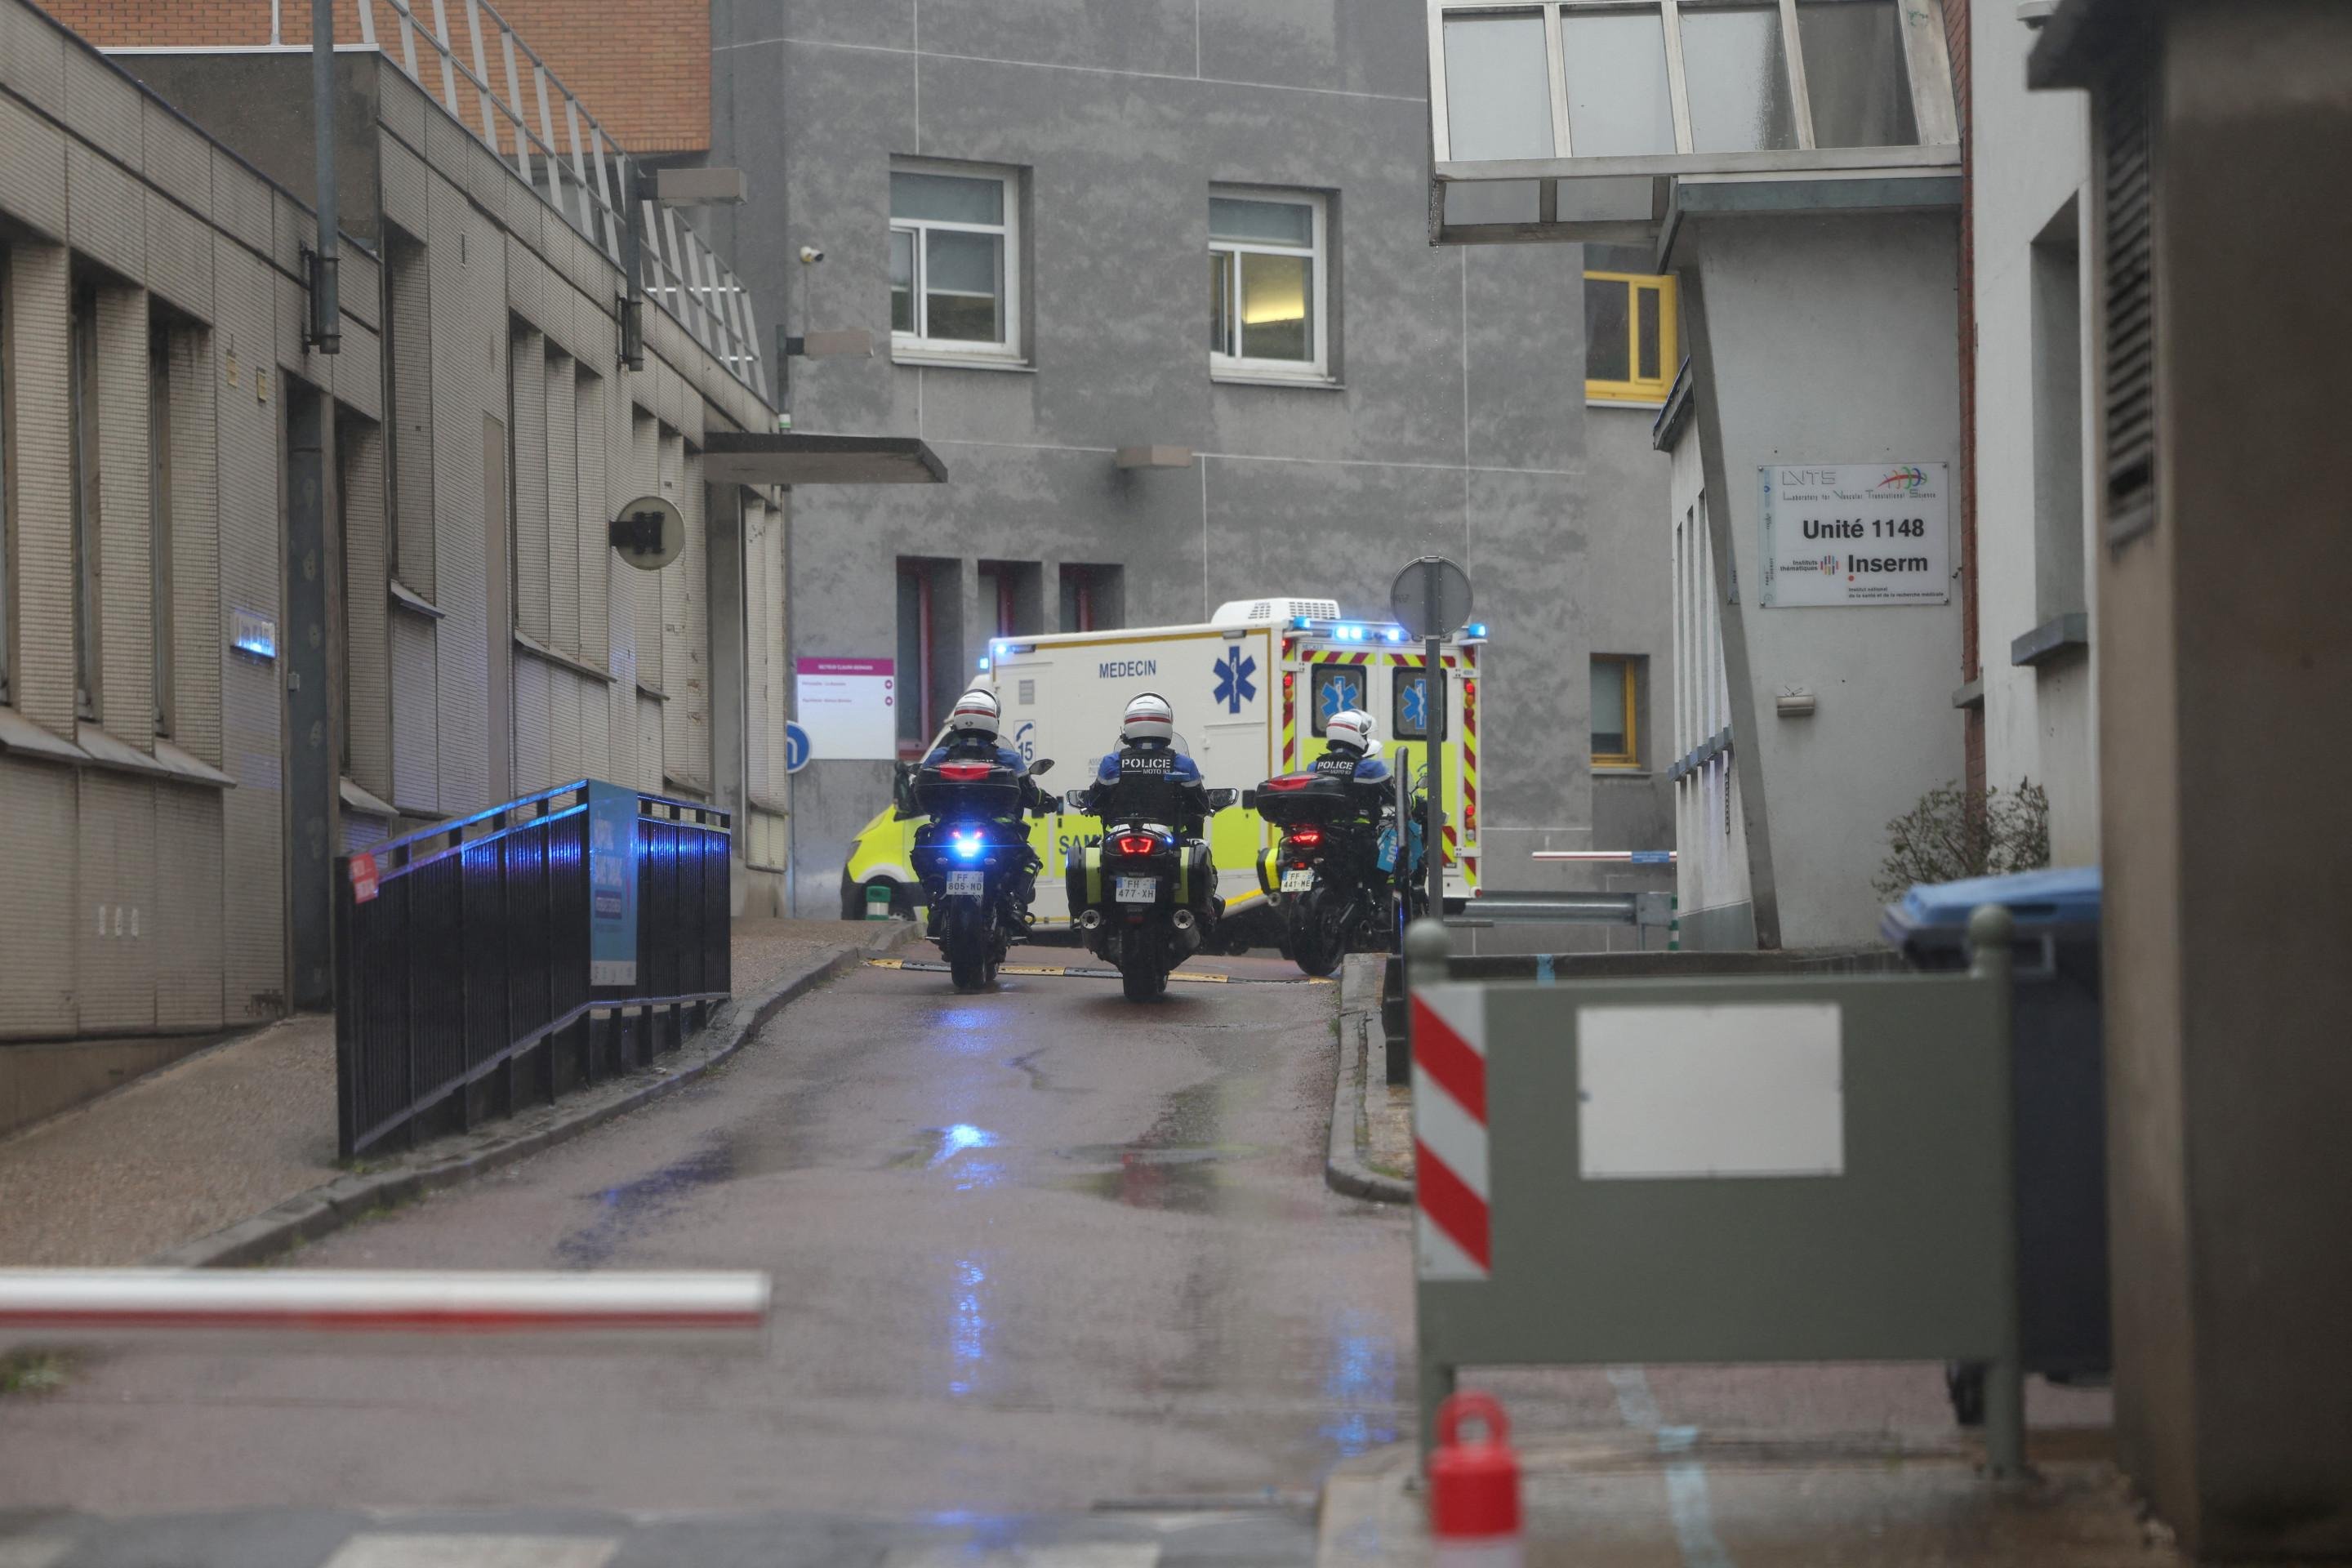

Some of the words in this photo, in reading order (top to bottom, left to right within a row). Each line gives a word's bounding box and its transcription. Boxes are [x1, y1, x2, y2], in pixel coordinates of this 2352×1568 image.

[1803, 519, 1864, 539] Unité
[1872, 519, 1925, 537] 1148
[1848, 555, 1928, 572] Inserm
[1099, 660, 1156, 679] MEDECIN
[1018, 742, 1033, 761] 15
[1121, 758, 1171, 768] POLICE
[1317, 760, 1354, 770] POLICE
[1059, 835, 1102, 855] SAM
[957, 874, 968, 882] FF
[948, 882, 982, 891] 805-MD
[1127, 880, 1140, 889] FH
[1118, 889, 1154, 898] 477-XH
